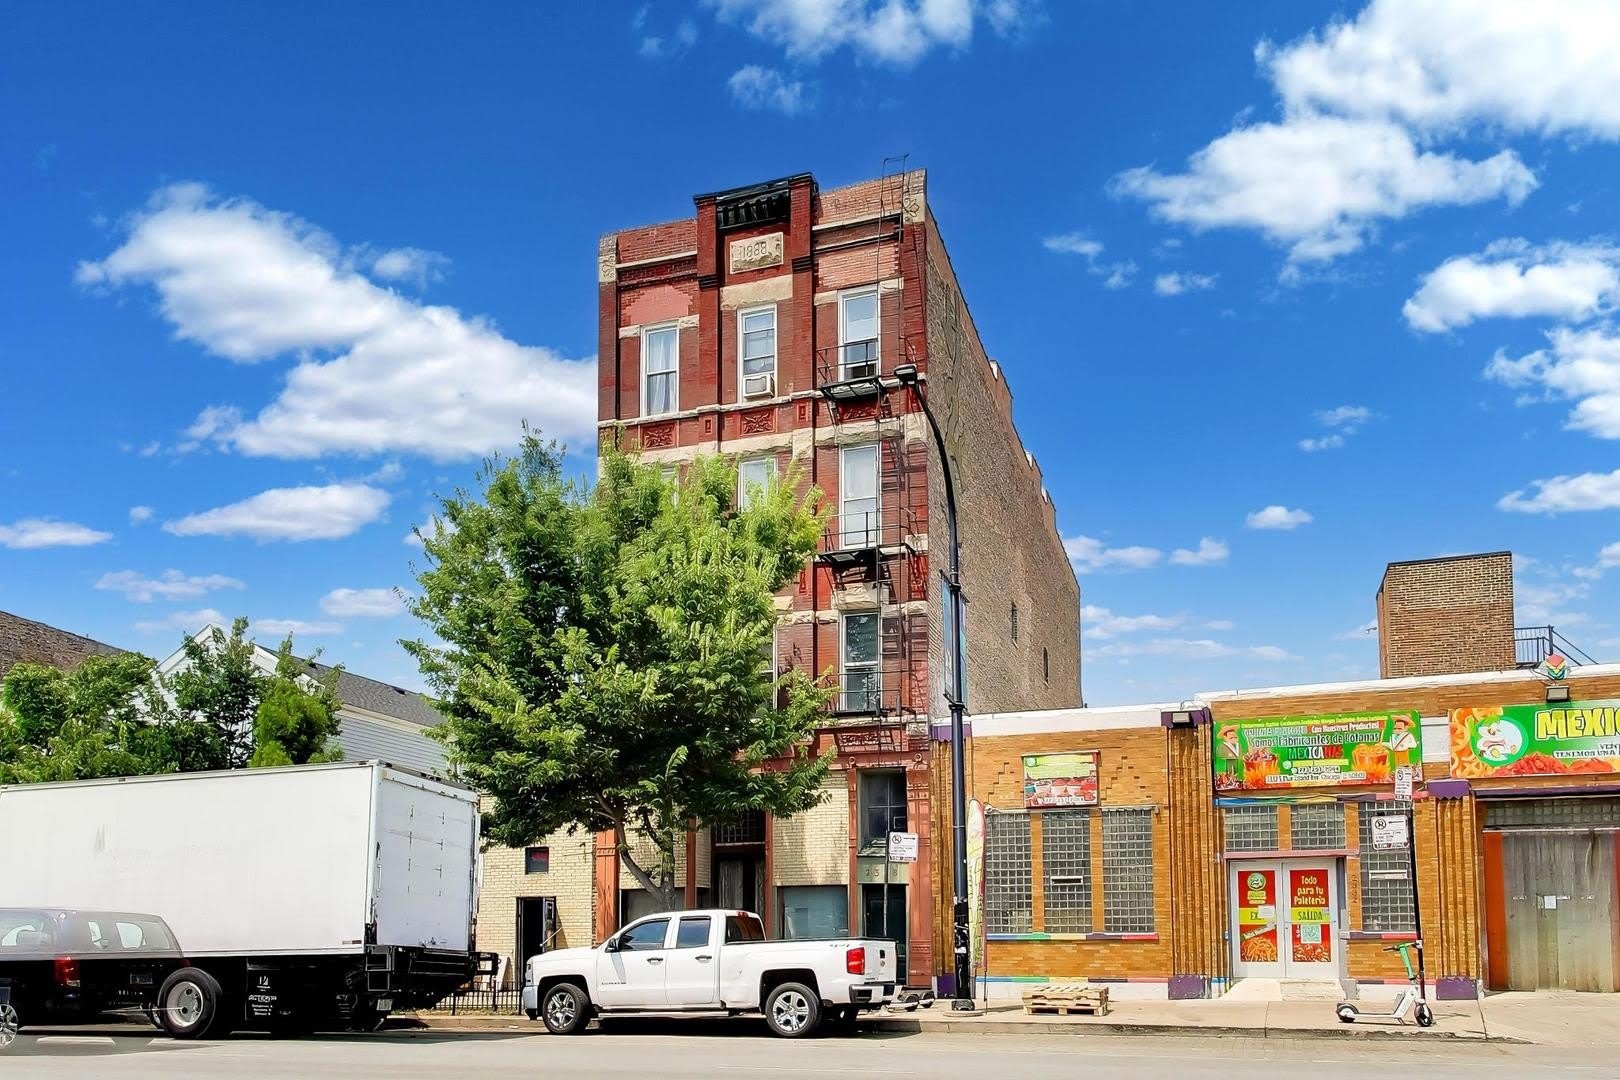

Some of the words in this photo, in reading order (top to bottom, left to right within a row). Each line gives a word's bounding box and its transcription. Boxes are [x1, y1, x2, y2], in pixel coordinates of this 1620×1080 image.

[1251, 737, 1276, 747] Somos
[1333, 734, 1343, 743] de
[1301, 875, 1317, 885] Todo
[1297, 887, 1314, 896] para
